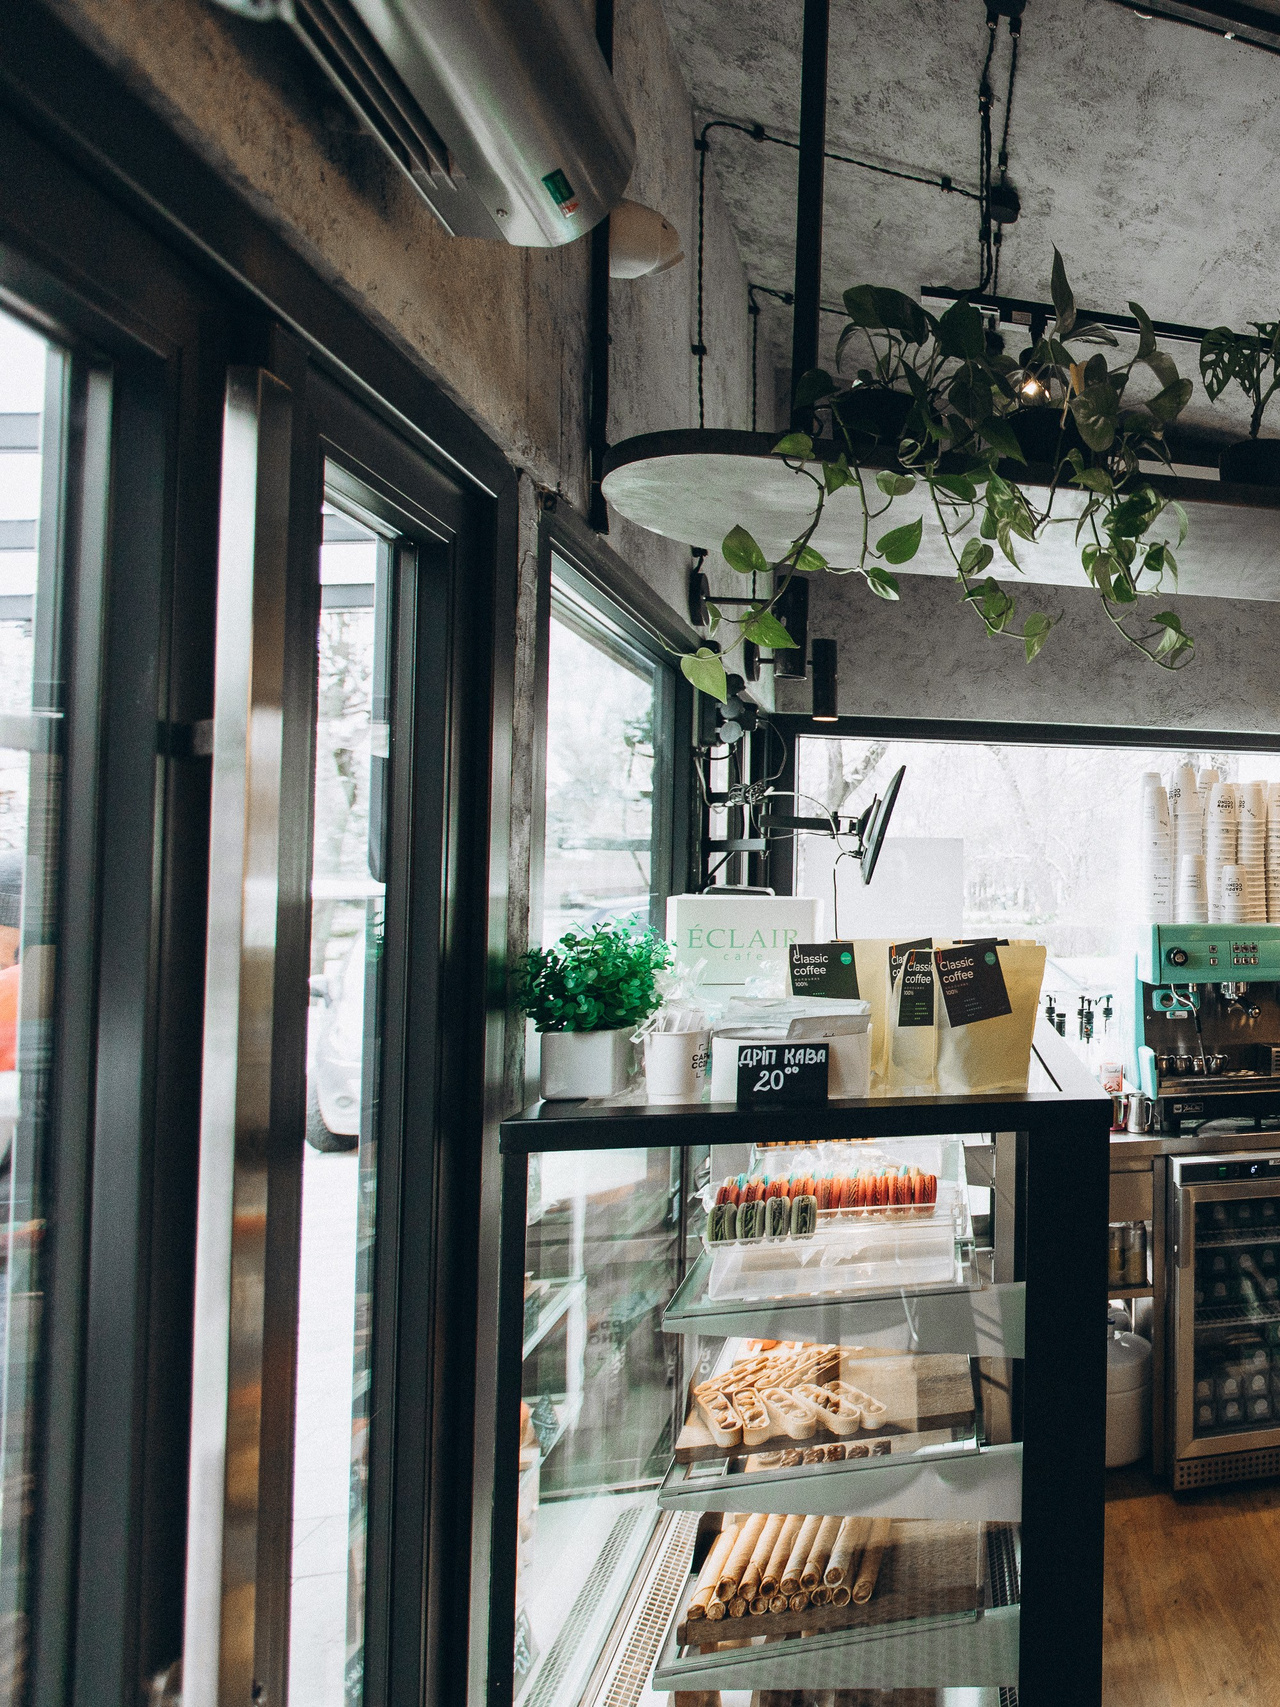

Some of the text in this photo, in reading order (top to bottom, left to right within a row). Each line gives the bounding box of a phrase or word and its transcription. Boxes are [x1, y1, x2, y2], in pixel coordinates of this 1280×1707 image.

[687, 924, 799, 949] ÉCLAIR
[723, 952, 763, 961] cafe
[793, 954, 828, 963] Classic
[940, 957, 975, 971] Classic
[794, 965, 826, 975] coffee
[905, 973, 931, 983] coffee
[943, 970, 974, 983] coffee
[784, 1048, 826, 1065] КАВА
